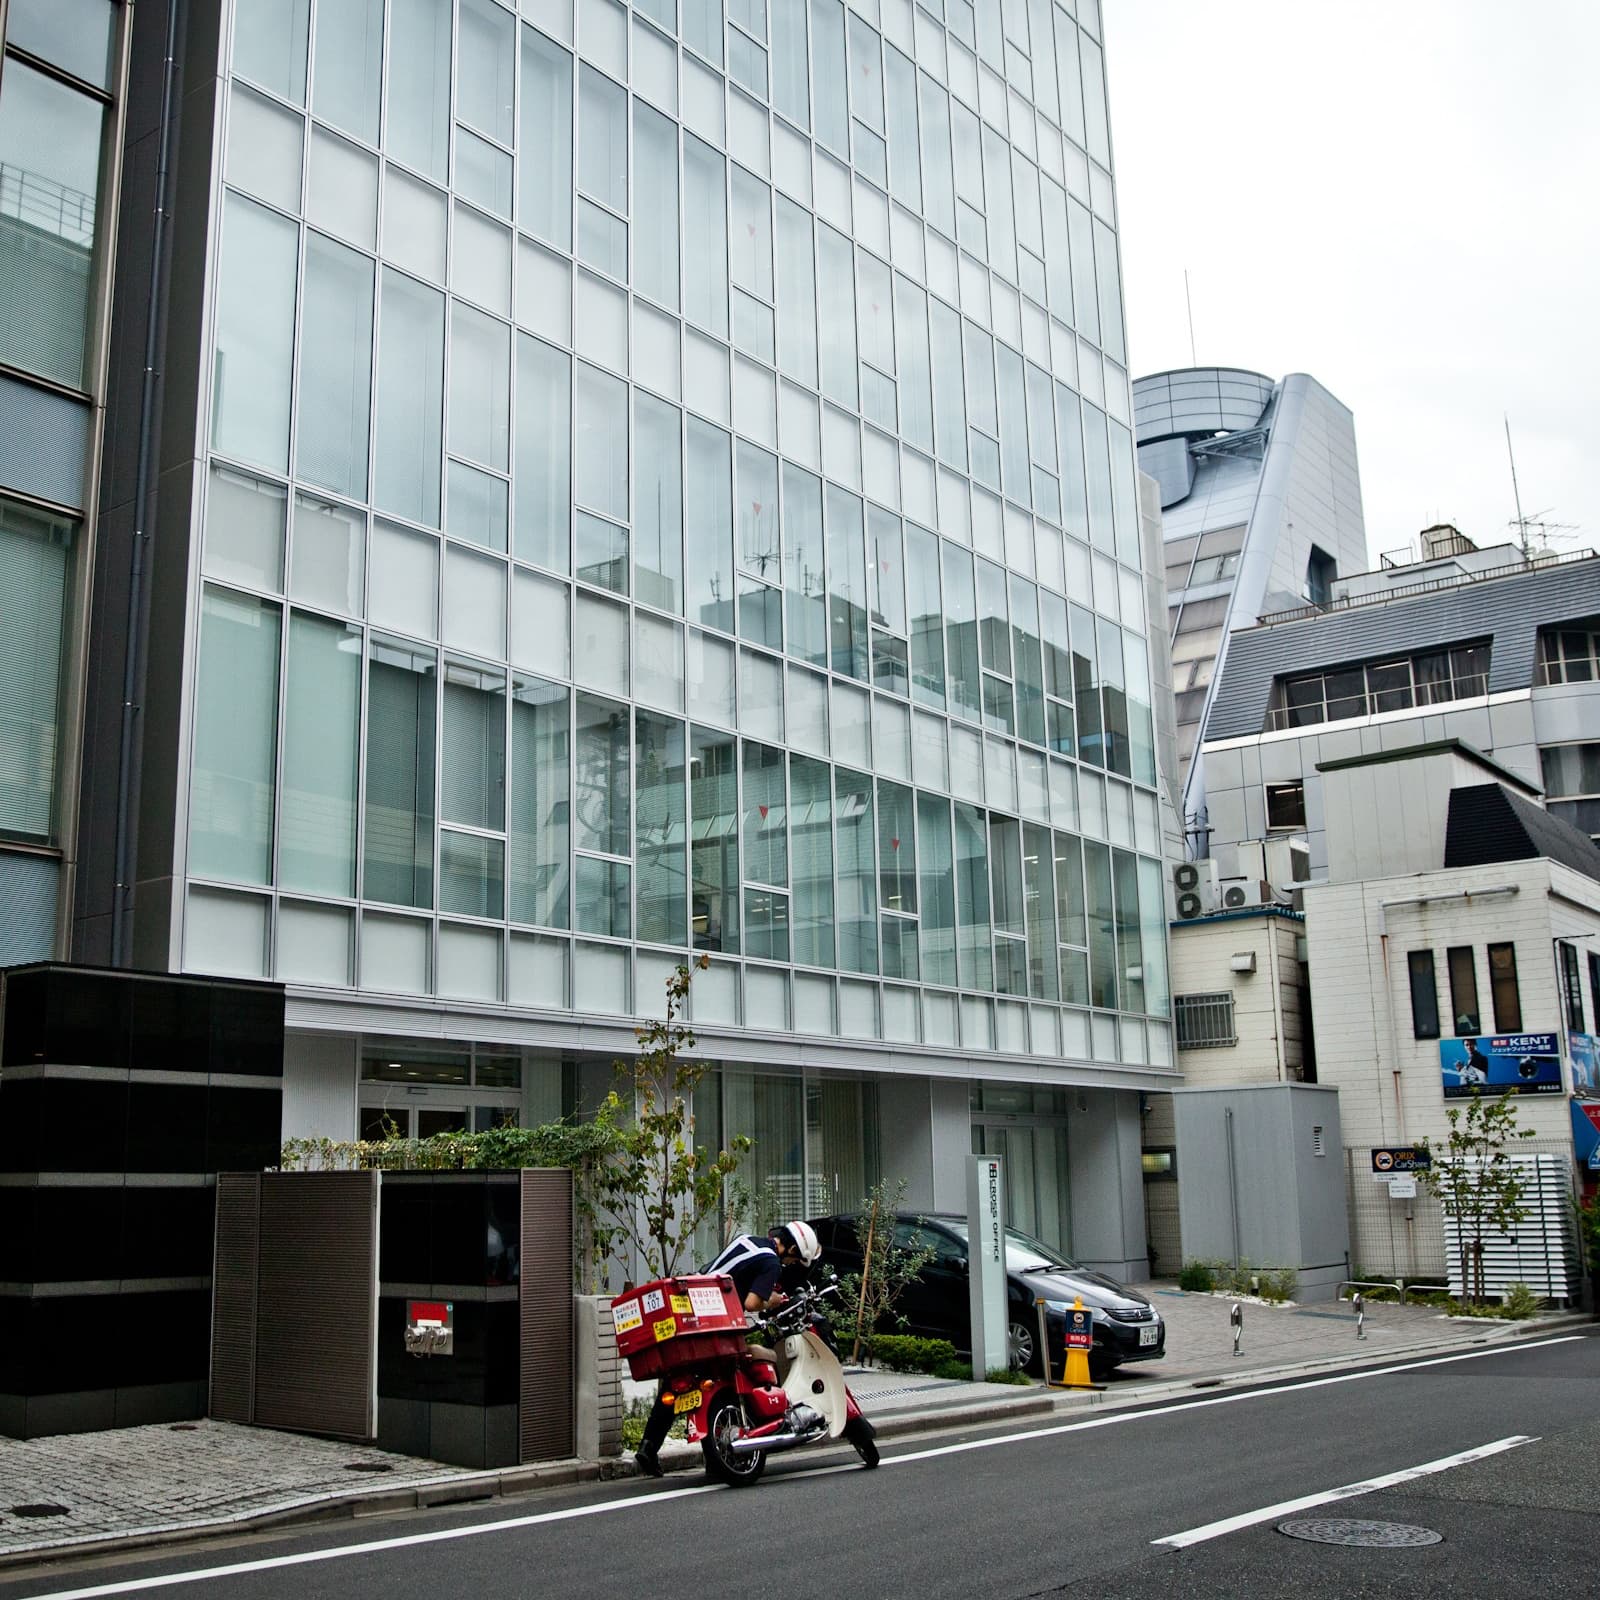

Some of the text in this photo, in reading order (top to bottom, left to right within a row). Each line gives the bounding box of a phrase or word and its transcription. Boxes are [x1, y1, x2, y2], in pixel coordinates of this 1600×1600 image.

[1509, 1036, 1550, 1046] KENT
[1394, 1152, 1415, 1160] ORIX
[1394, 1160, 1429, 1169] CarShare
[992, 1222, 1000, 1263] OFFICE
[647, 1297, 660, 1311] 107
